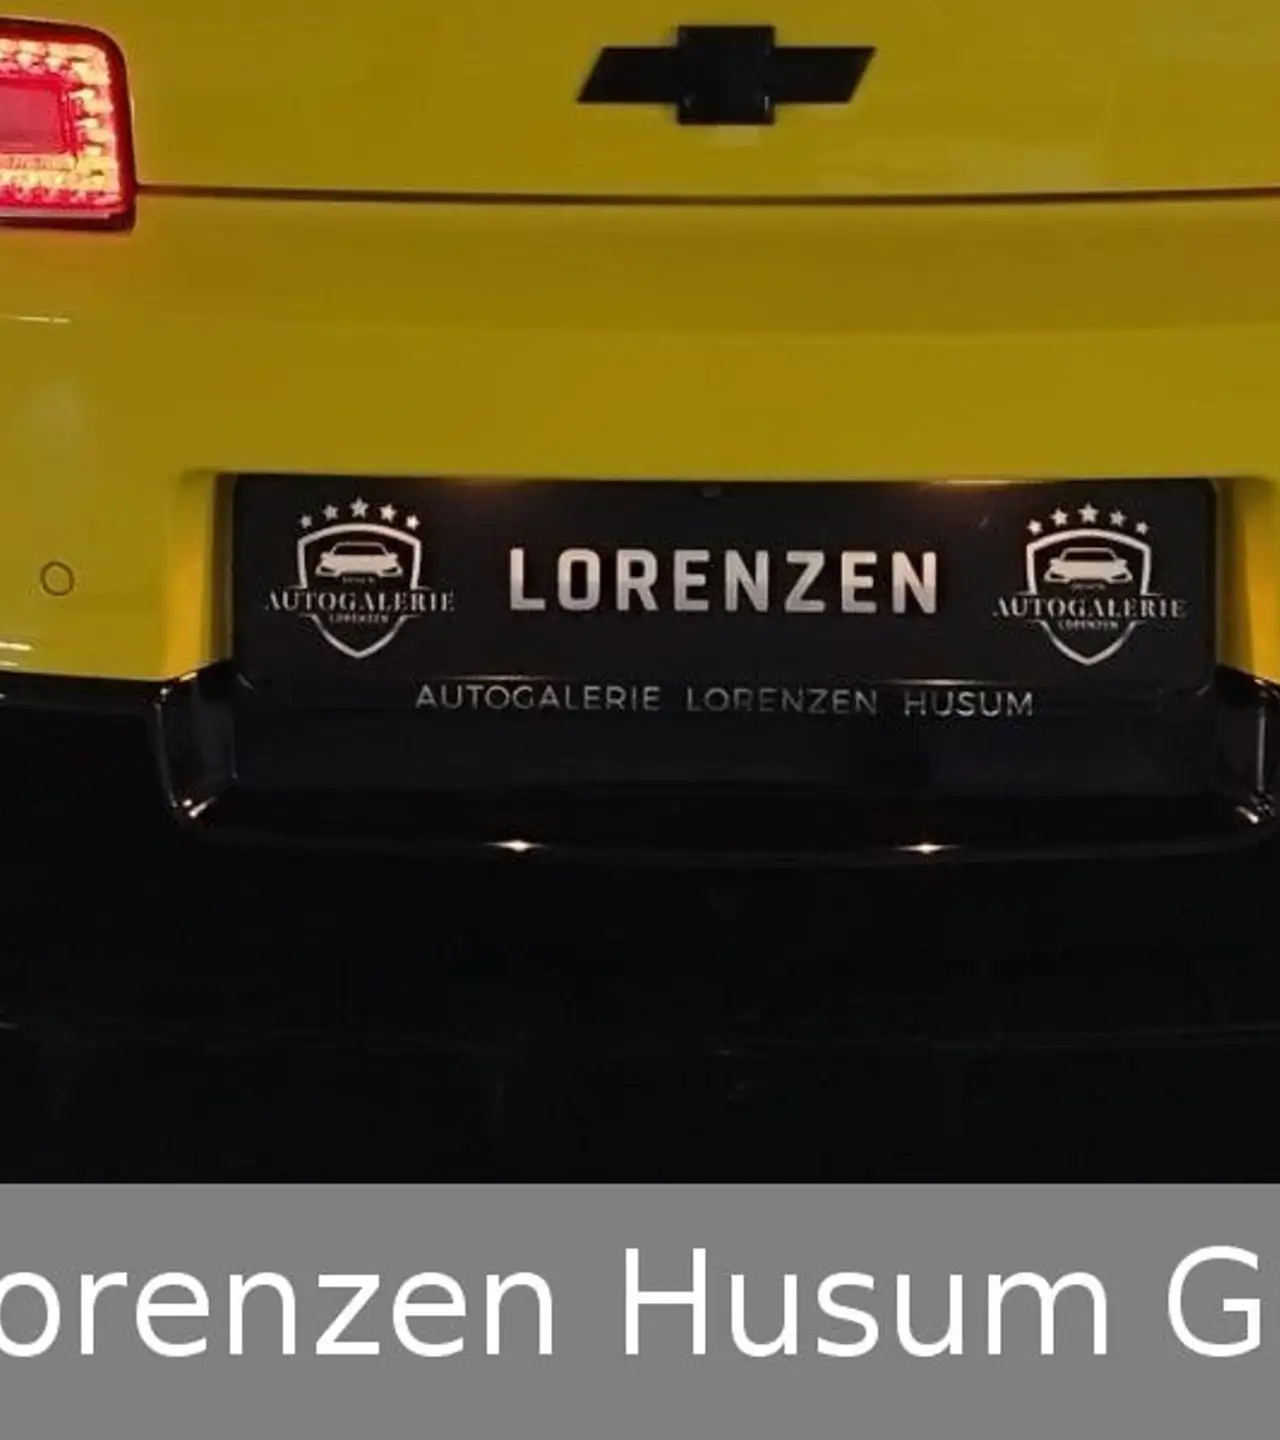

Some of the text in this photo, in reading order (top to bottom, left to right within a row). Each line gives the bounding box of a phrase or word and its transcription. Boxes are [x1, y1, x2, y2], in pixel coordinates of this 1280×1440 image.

[510, 546, 938, 615] LORENZEN
[265, 591, 455, 612] AUTOGALERIE
[993, 596, 1189, 619] AUTOGALERIE
[415, 682, 1034, 718] AUTOGALERIE LORENZEN HUSUM
